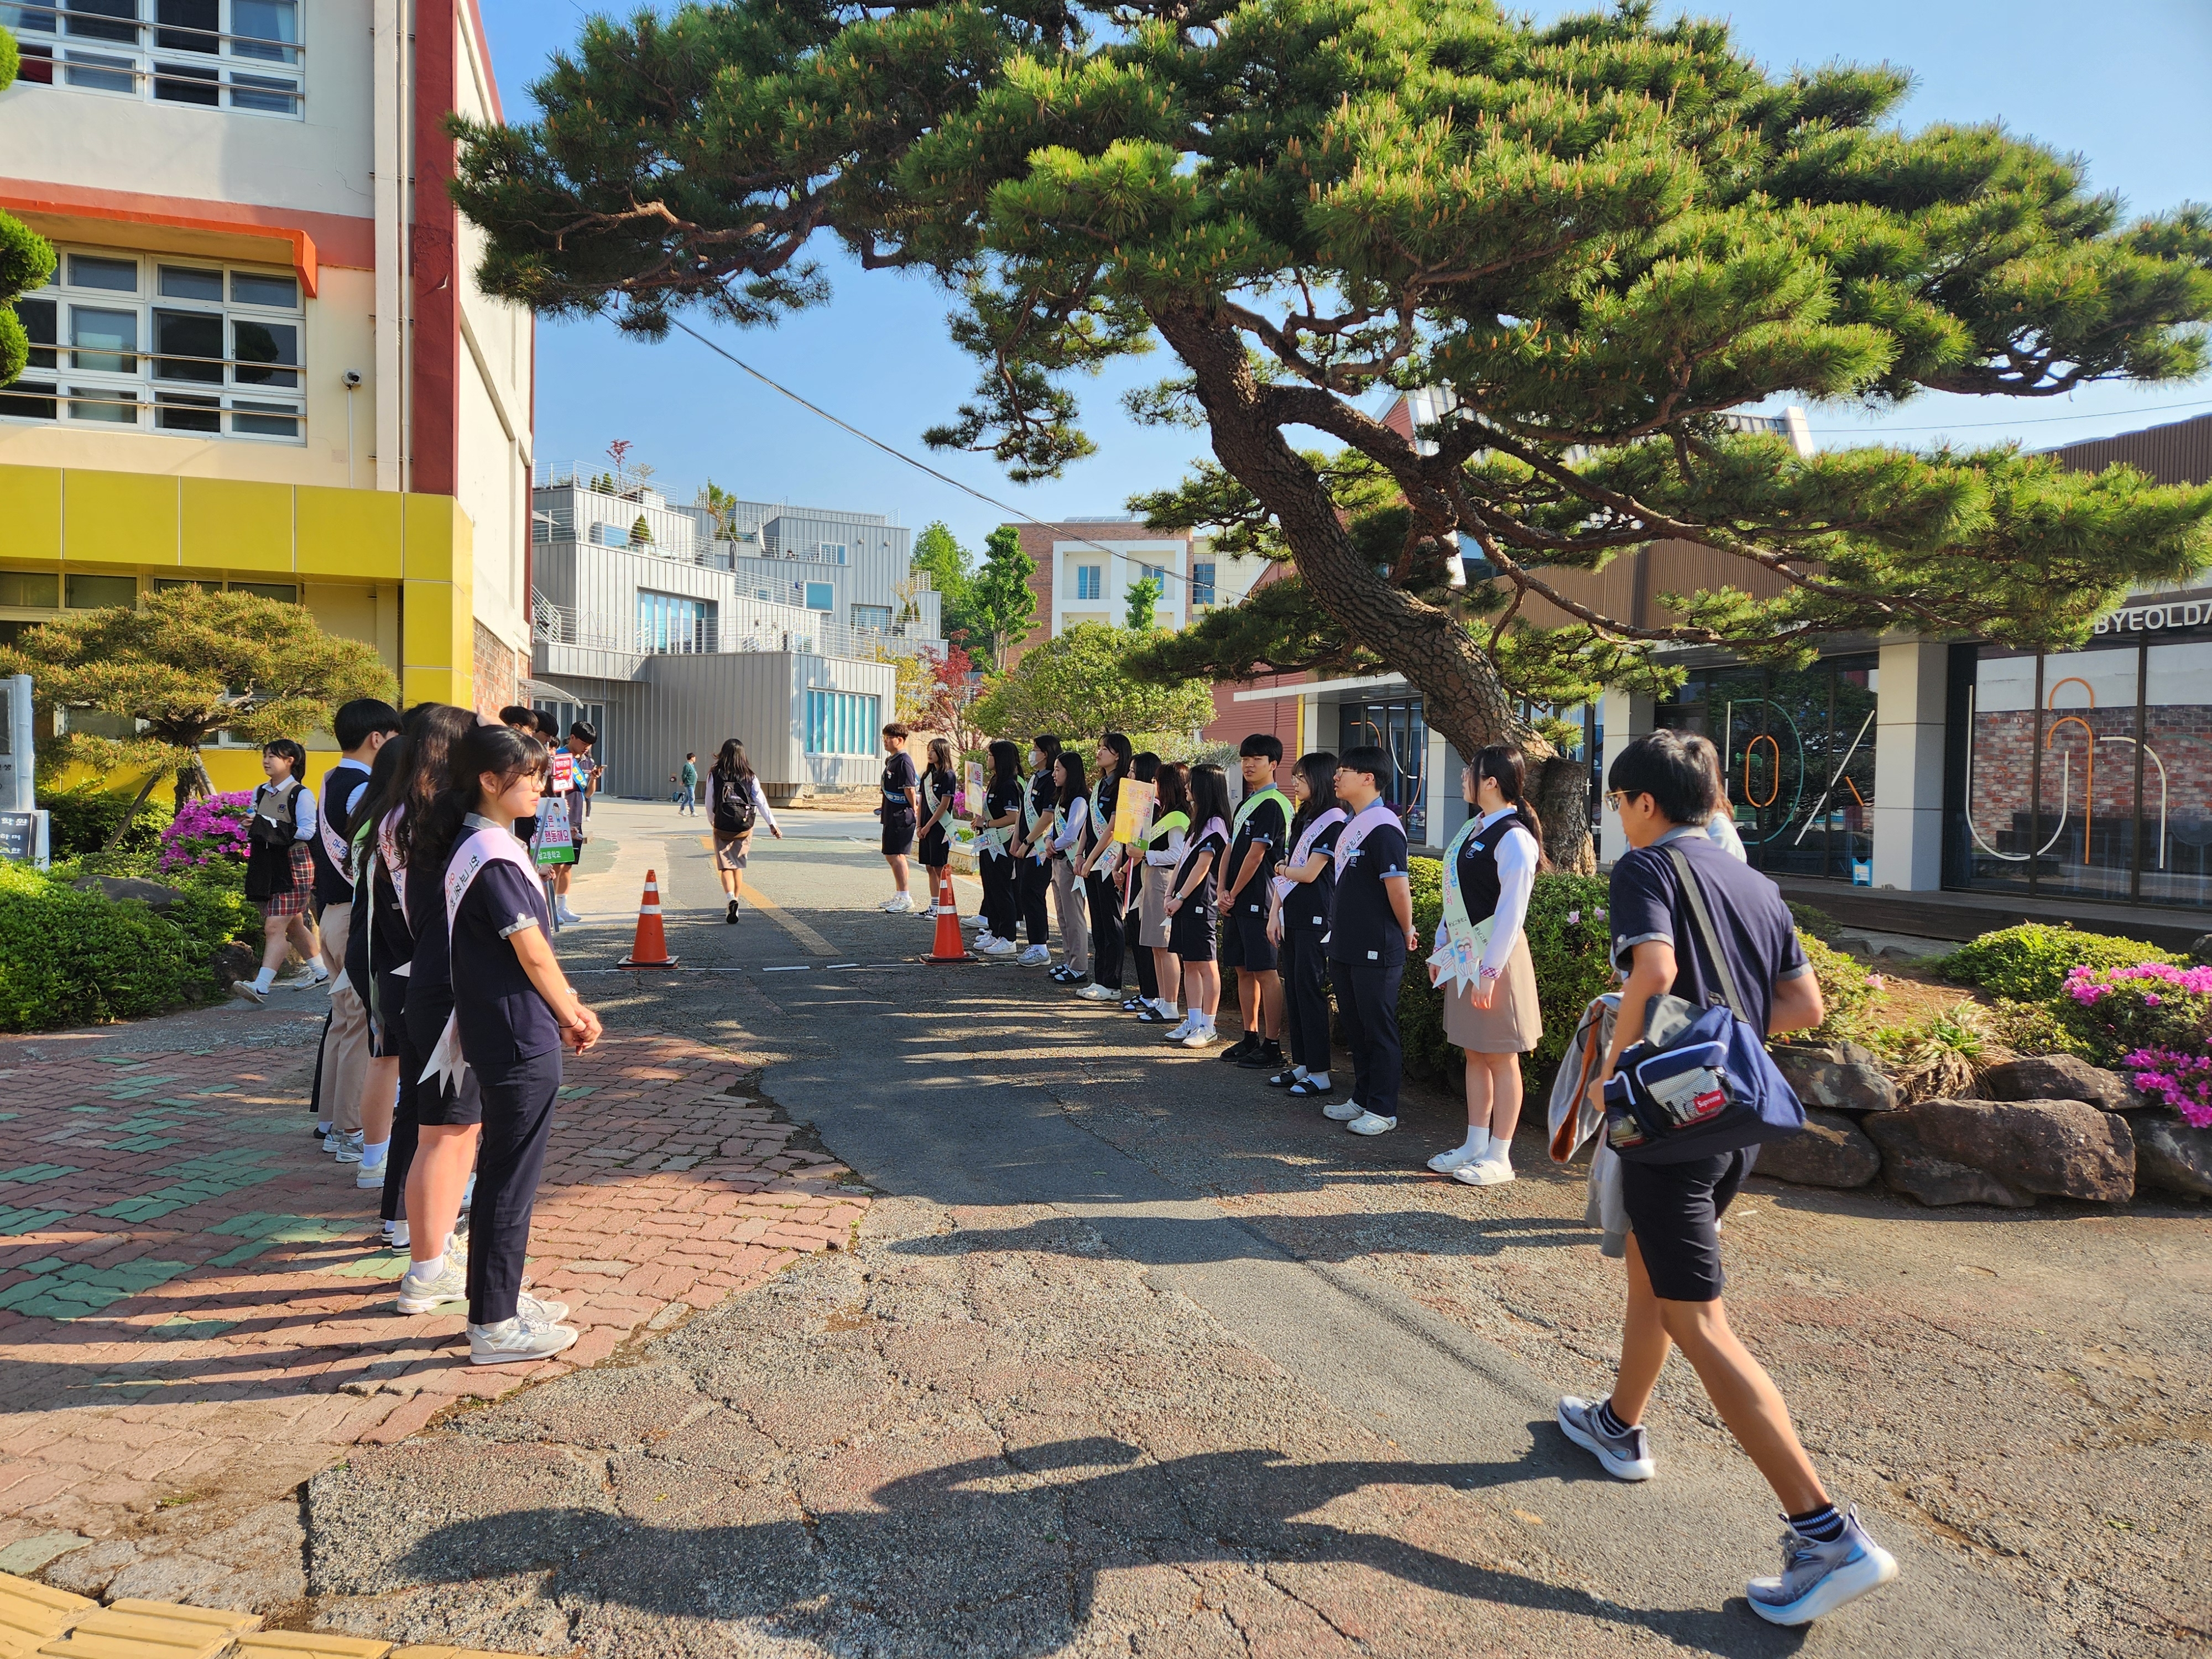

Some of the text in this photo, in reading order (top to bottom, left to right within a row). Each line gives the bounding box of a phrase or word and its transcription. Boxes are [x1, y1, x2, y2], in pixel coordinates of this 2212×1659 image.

[545, 830, 570, 843] 행동해요
[538, 851, 561, 860] 남고등학교
[449, 854, 480, 915] 학교폭력
[1697, 1095, 1721, 1108] Supreme
